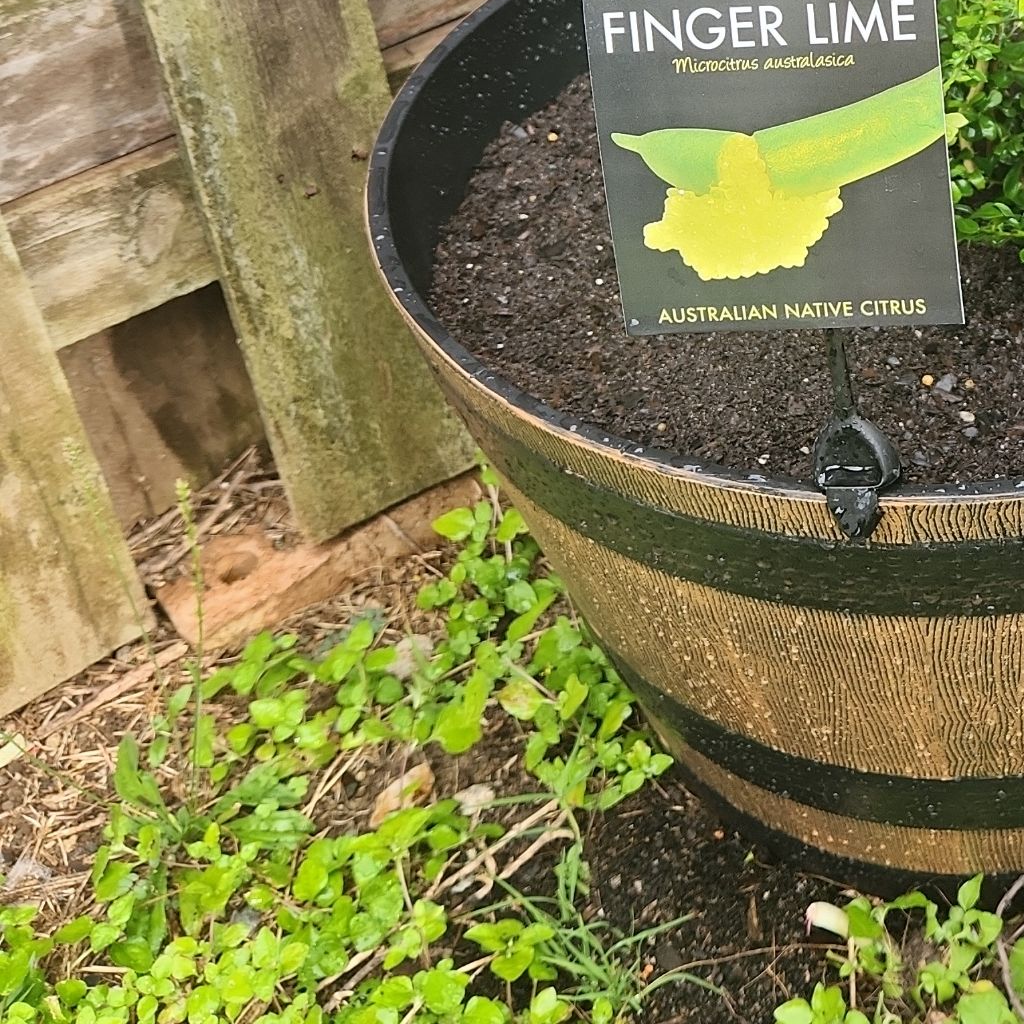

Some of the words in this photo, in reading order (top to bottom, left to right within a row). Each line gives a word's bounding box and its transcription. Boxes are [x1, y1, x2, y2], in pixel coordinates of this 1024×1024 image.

[602, 5, 788, 54] FINGER
[672, 55, 759, 74] Microcitrus
[763, 51, 856, 71] australasica
[658, 304, 777, 324] AUSTRALIAN
[784, 300, 854, 319] NATIVE
[860, 298, 927, 317] CITRUS
